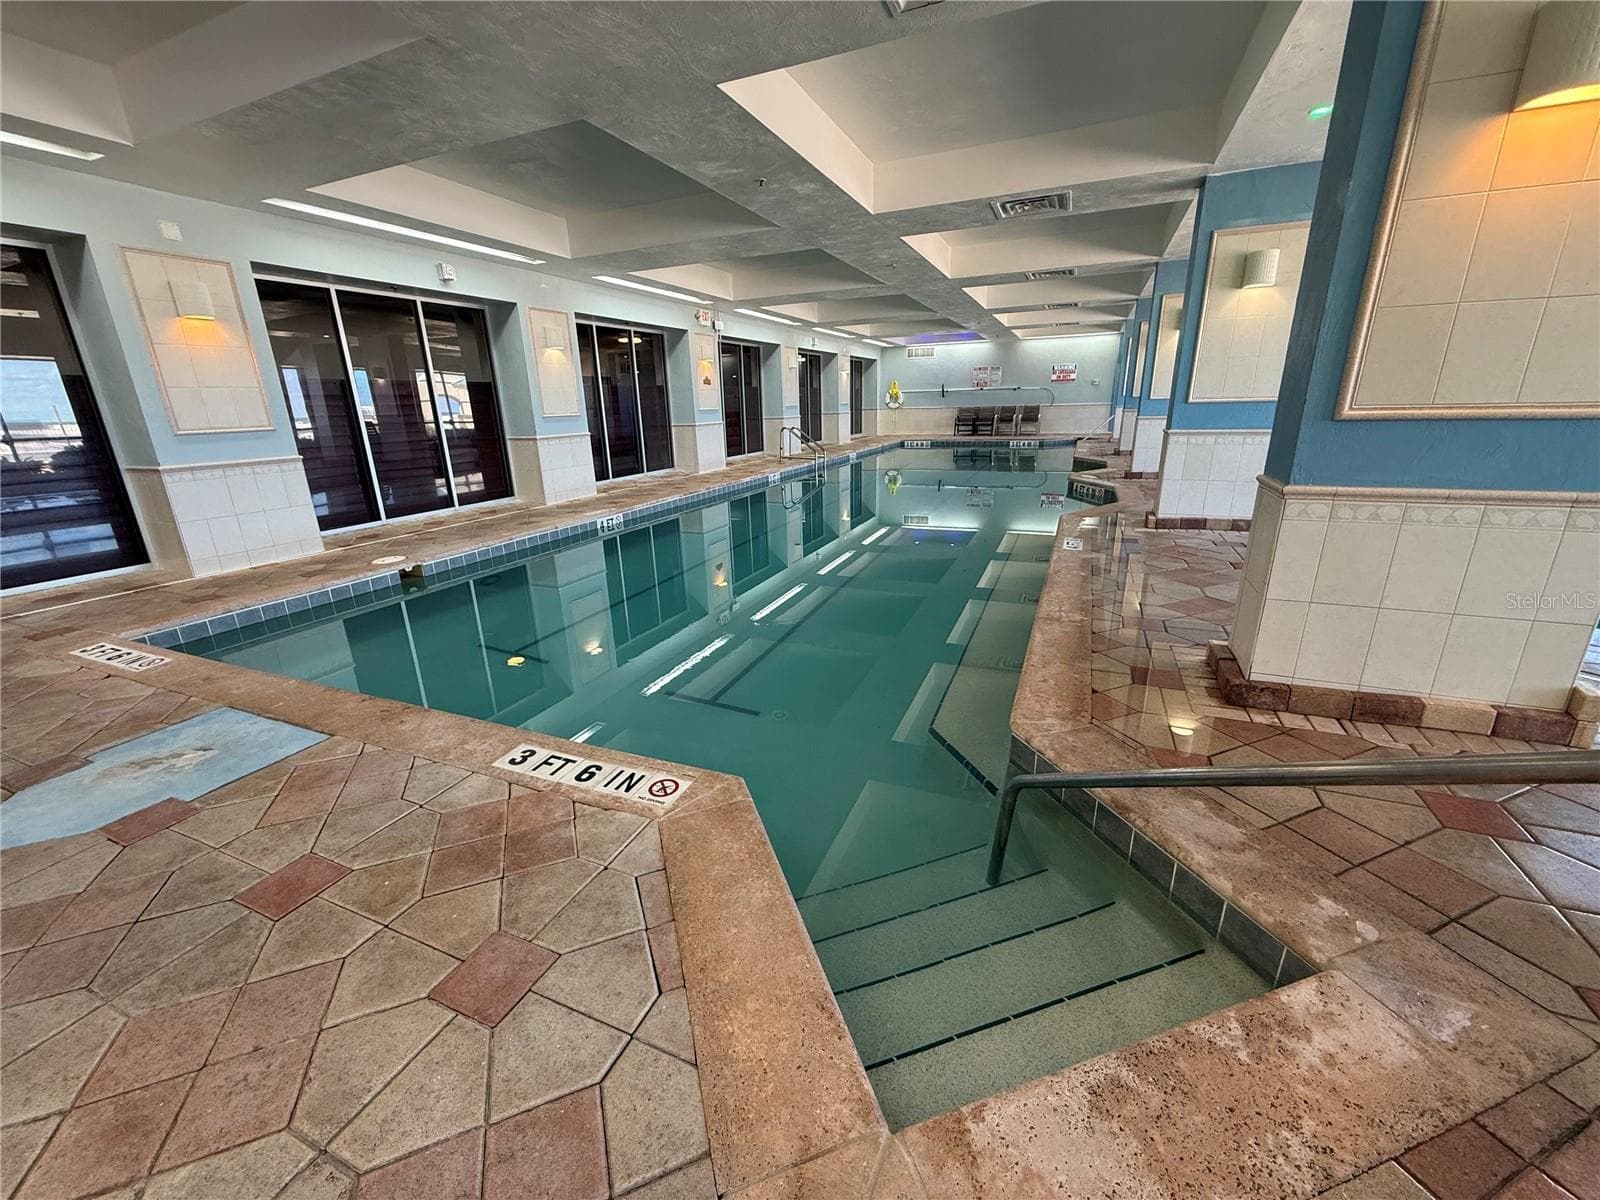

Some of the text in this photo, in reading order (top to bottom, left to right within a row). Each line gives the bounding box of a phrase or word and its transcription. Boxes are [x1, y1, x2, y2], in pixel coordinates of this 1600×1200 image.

[80, 644, 151, 666] 3 FT 6 IN
[508, 749, 645, 793] 3 FT 6 IN
